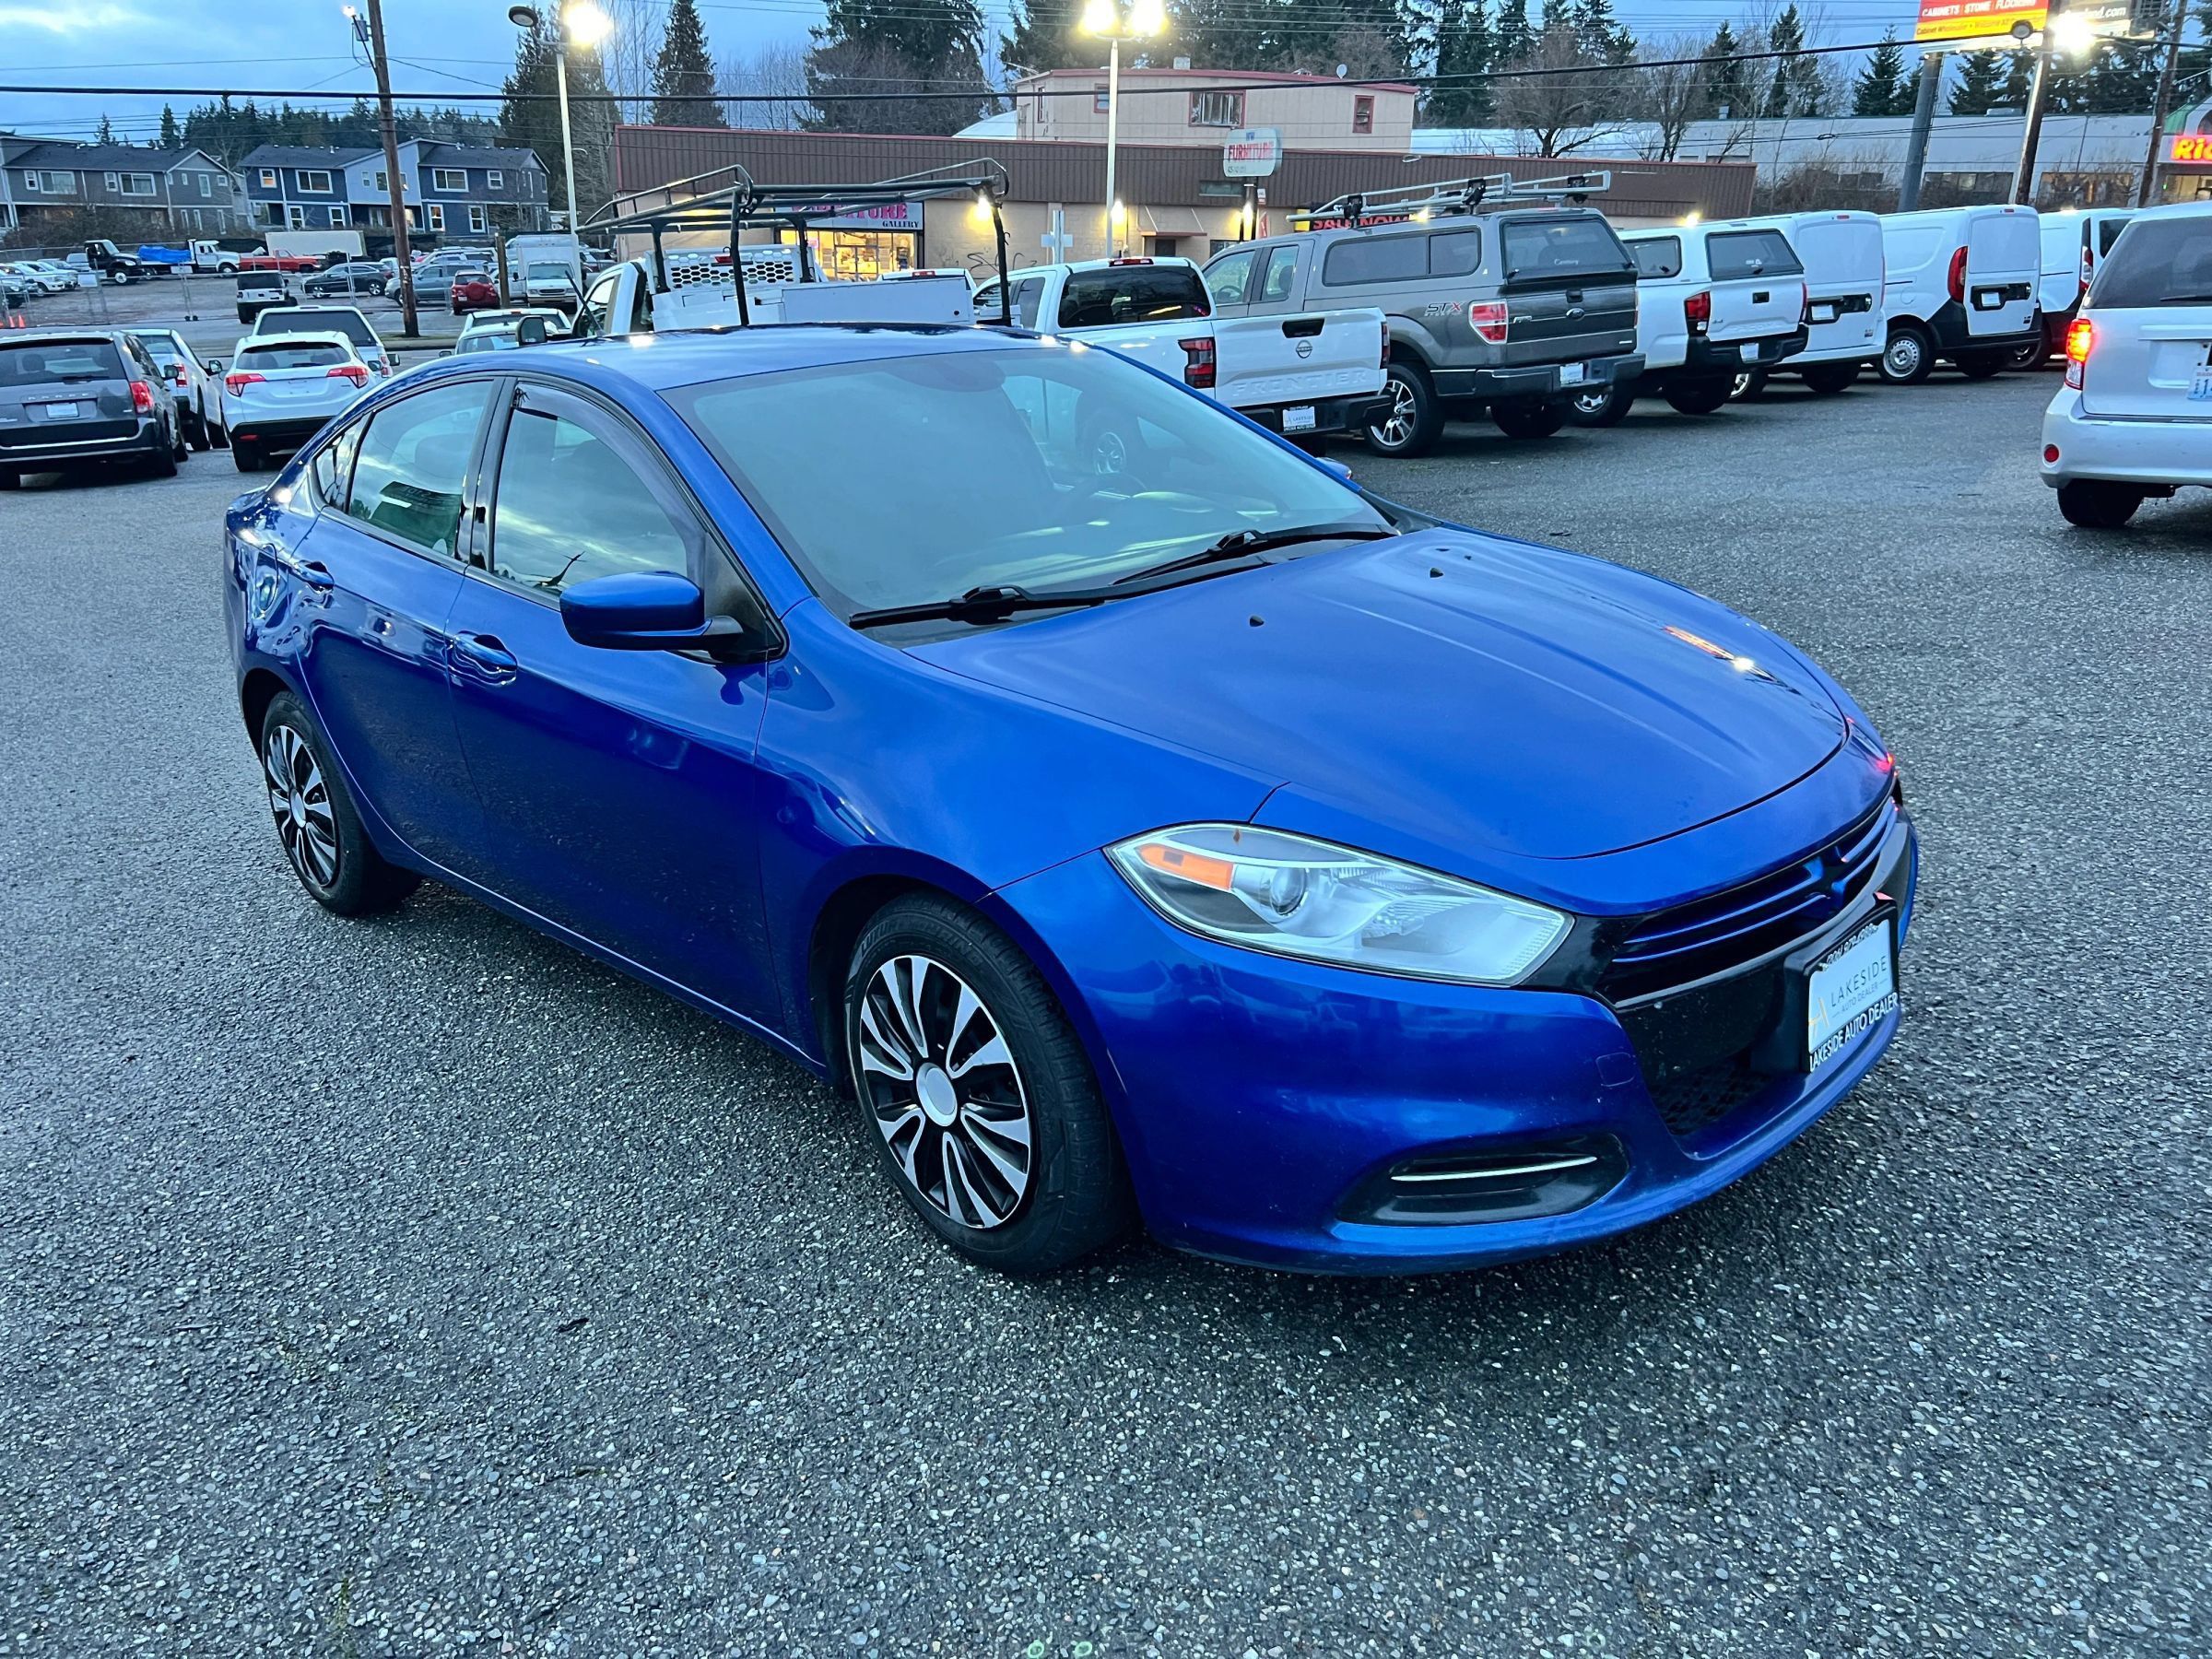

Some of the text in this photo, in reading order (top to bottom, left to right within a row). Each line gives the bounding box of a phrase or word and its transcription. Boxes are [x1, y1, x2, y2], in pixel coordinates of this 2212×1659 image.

[1922, 4, 1960, 17] CABINETS
[1964, 2, 1991, 14] STONE
[1228, 141, 1275, 162] FURNITURE
[882, 220, 919, 229] GALLERY
[1427, 302, 1462, 312] STX
[1231, 370, 1367, 397] FRONTIER
[1830, 955, 1888, 1007] LAKESIDE
[1841, 982, 1879, 1012] AUTO DEALER
[1809, 992, 1899, 1072] LAKESIDE AUTO DEALER
